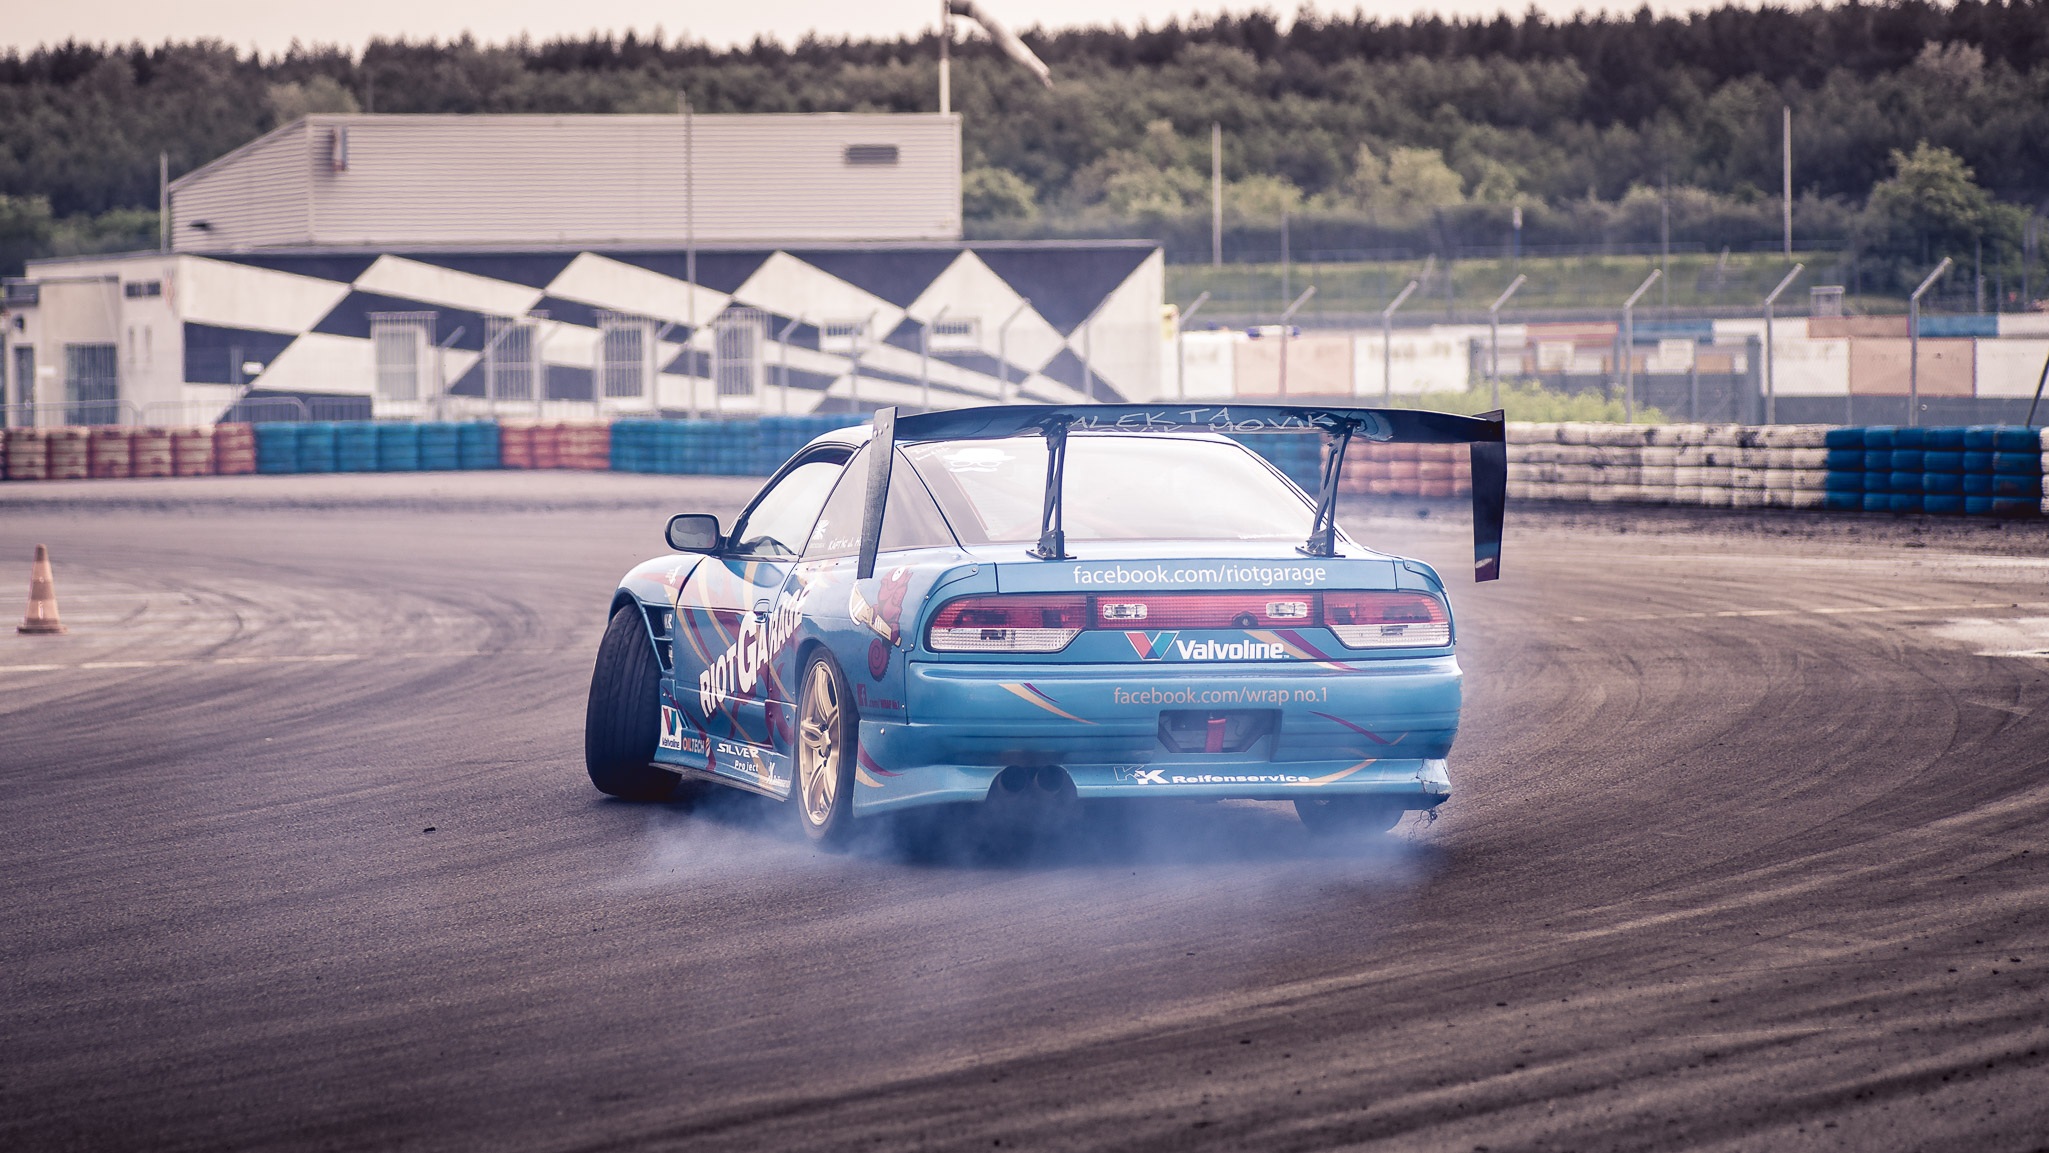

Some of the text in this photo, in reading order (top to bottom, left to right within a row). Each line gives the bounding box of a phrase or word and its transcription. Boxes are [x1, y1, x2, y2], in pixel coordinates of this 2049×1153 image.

[1073, 565, 1327, 586] facebook.com/riotgarage
[1176, 639, 1284, 660] Valvoline
[1114, 687, 1328, 706] facebook.com/wrap no.1
[717, 743, 760, 759] SILVER
[734, 760, 759, 772] Project
[1172, 774, 1310, 784] Reifenservice
